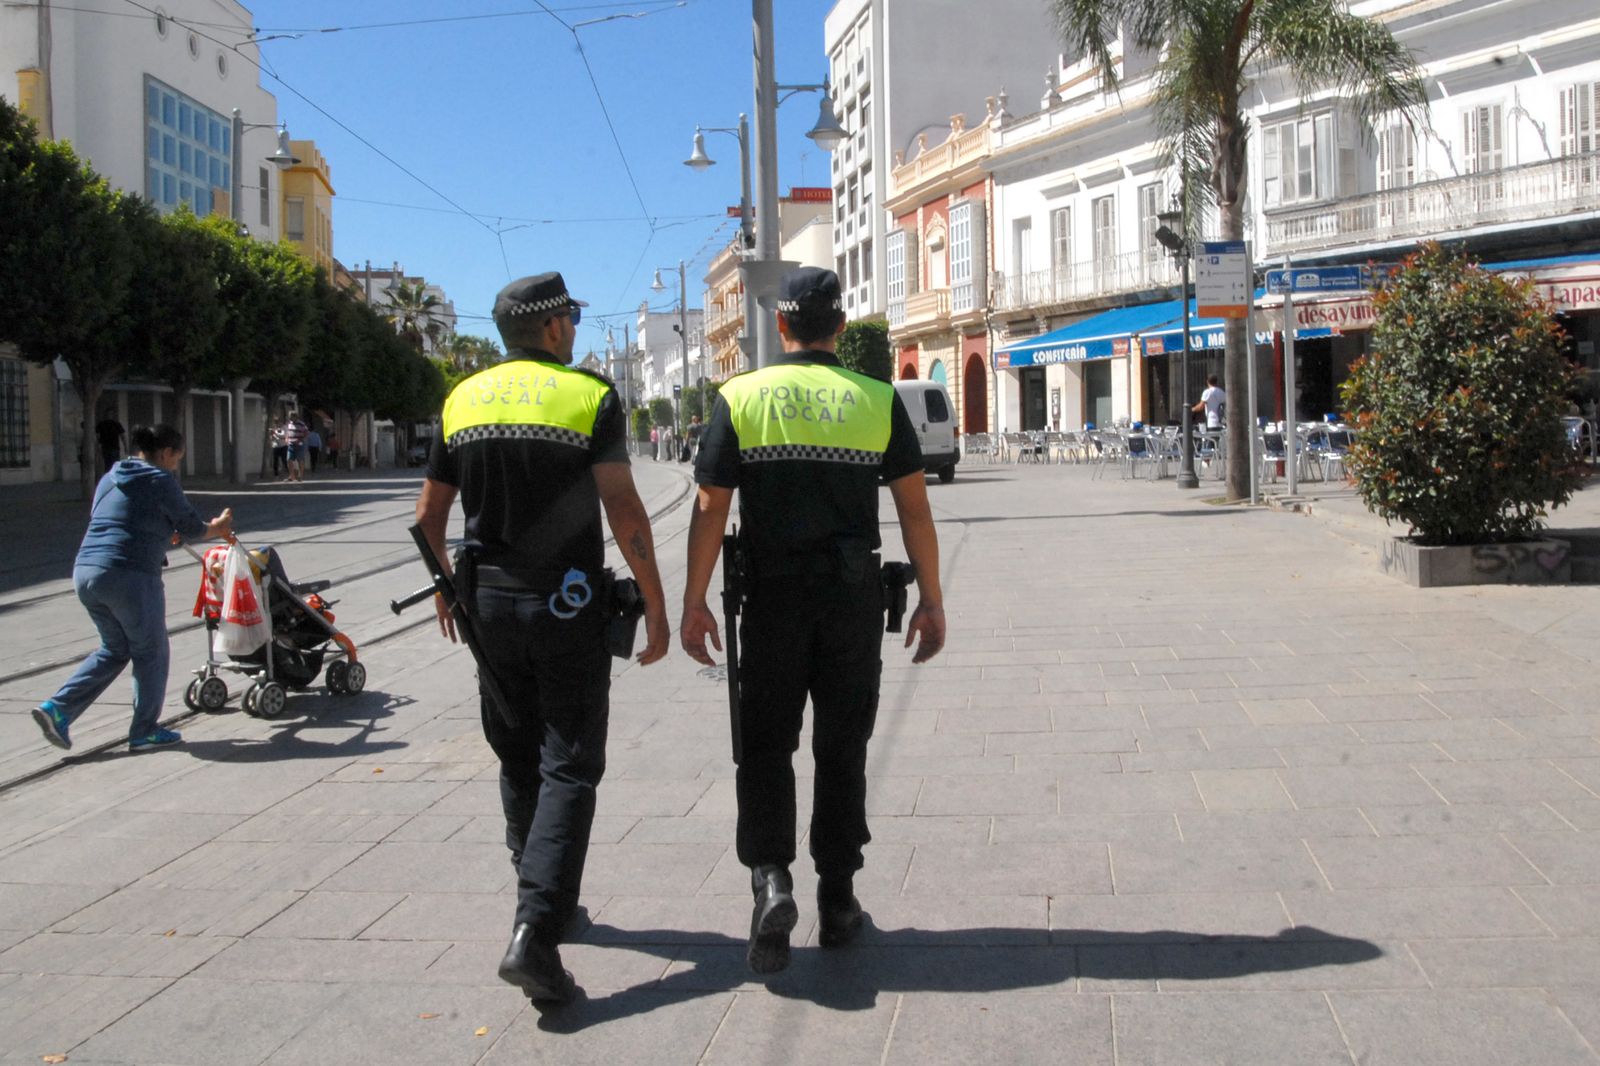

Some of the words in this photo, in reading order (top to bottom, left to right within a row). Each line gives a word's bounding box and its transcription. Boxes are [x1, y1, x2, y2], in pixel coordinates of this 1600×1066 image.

[1032, 344, 1087, 363] CONFITERÍA
[466, 375, 558, 394] OLICIA
[470, 391, 544, 406] LOCAL
[760, 386, 856, 405] POLICIA
[770, 404, 846, 423] LOCAL
